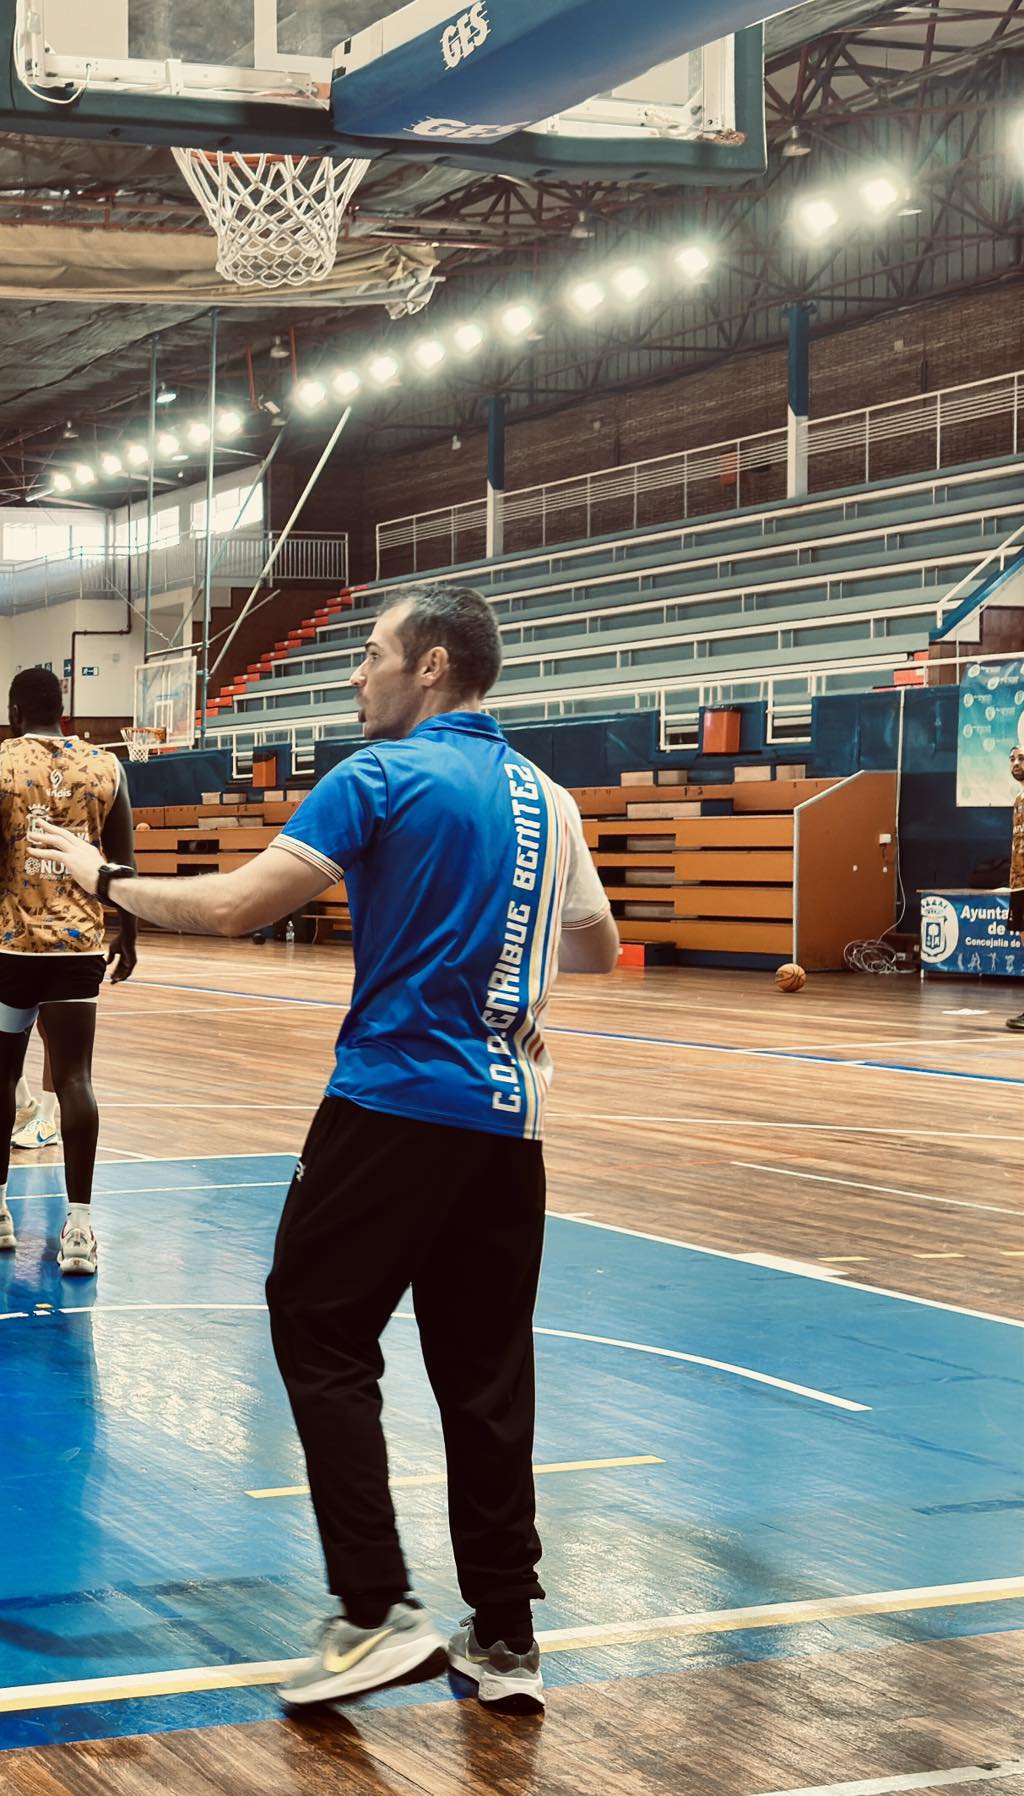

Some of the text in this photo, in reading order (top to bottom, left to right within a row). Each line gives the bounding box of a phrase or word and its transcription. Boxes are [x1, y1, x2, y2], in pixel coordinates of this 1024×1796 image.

[440, 1, 490, 70] GES
[960, 905, 1010, 922] Ayunta
[987, 921, 1006, 936] de
